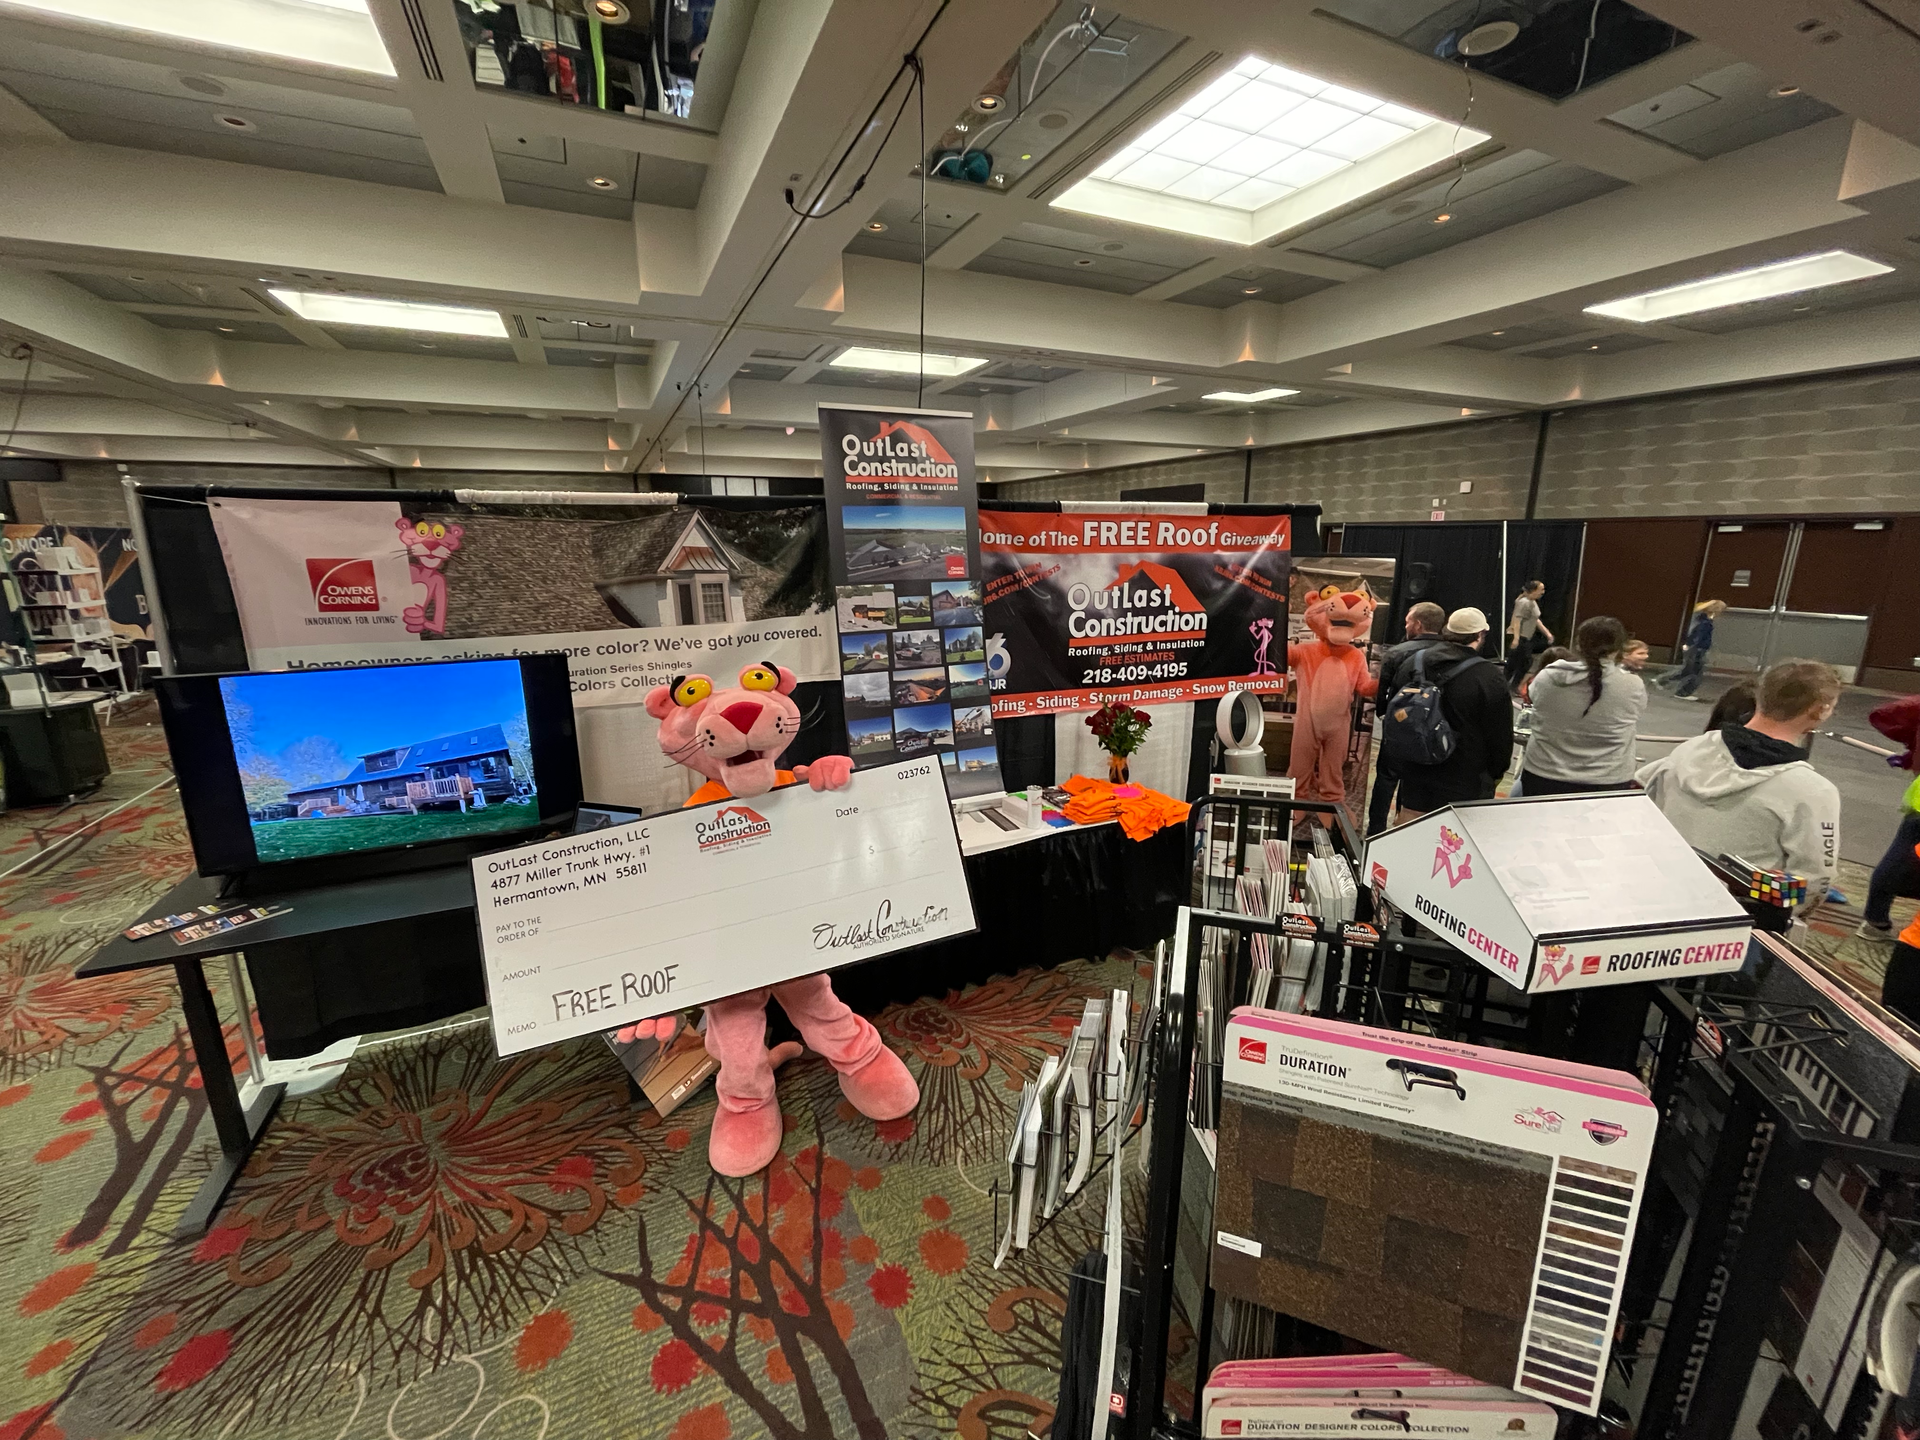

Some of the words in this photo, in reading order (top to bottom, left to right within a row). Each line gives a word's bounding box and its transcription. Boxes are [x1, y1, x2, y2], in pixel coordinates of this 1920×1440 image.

[842, 434, 927, 457] OutLast
[843, 455, 958, 477] Construction
[846, 483, 882, 491] Roofing,
[883, 483, 910, 491] Siding
[912, 483, 918, 491] &
[920, 483, 958, 491] Insulation
[1028, 531, 1047, 547] of
[1049, 531, 1079, 547] The
[1083, 521, 1151, 546] FREE
[1156, 521, 1219, 546] Roof
[1220, 532, 1286, 547] Giveaway
[327, 585, 374, 595] OWENS
[986, 574, 1014, 591] ENTER
[320, 595, 376, 605] CORNING
[1067, 582, 1172, 611] OutLast
[305, 617, 351, 626] INNOVATIONS
[355, 616, 369, 625] FOR
[1068, 606, 1208, 638] Construction
[596, 639, 650, 656] color?
[654, 637, 703, 652] We've
[708, 634, 733, 651] got
[736, 631, 760, 648] you
[763, 626, 822, 642] covered.
[1068, 646, 1112, 657] Roofing,
[1114, 644, 1143, 654] Siding
[1146, 642, 1153, 650] &
[1157, 639, 1205, 650] Insulation
[568, 664, 607, 678] uration
[610, 662, 644, 674] Series
[647, 659, 692, 673] Shingles
[1099, 655, 1123, 666] FREE
[1124, 652, 1175, 665] ESTIMATES
[569, 677, 616, 692] Colors
[620, 673, 676, 688] Collecti
[1082, 662, 1188, 684] 218-409-4195
[992, 700, 1027, 714] ofing
[1036, 694, 1079, 709] Siding
[1089, 691, 1131, 704] Storm
[1133, 686, 1183, 701] Damage
[1192, 682, 1226, 695] Snow
[1228, 678, 1284, 692] Removal
[897, 765, 932, 780] 023762
[835, 806, 859, 818] Date
[695, 814, 748, 834] OutLast
[697, 821, 771, 845] Construction
[488, 854, 538, 874] OutLast
[542, 837, 623, 862] Construction,
[626, 828, 651, 843] LLC
[1821, 822, 1834, 867] EAGLE
[490, 875, 521, 890] 4877
[526, 866, 563, 883] Miller
[565, 856, 600, 874] Trunk
[604, 851, 636, 866] Hwy.
[639, 844, 651, 857] #1
[493, 881, 580, 908] Hermantown,
[583, 872, 607, 888] MN
[616, 862, 648, 880] 55811
[495, 923, 512, 934] PAY
[513, 920, 525, 930] TO
[526, 916, 542, 925] THE
[1414, 893, 1467, 940] ROOFING
[1467, 927, 1519, 974] CENTER
[497, 931, 526, 944] ORDER
[527, 927, 540, 937] OF
[853, 934, 891, 950] AUTHORIZED
[891, 926, 925, 940] SIGNATURE
[1606, 948, 1682, 973] ROOFING
[1683, 941, 1745, 965] CENTER
[502, 966, 542, 982] AMOUNT
[552, 983, 617, 1021] FREE
[621, 964, 679, 1004] ROOF
[507, 1022, 537, 1036] MEMO
[1362, 1031, 1378, 1039] Trust
[1308, 1086, 1323, 1094] Wind
[1324, 1089, 1357, 1101] Resistance
[1358, 1095, 1382, 1107] Limited
[1305, 1423, 1358, 1431] DESIGNER
[1360, 1423, 1402, 1432] COLORS
